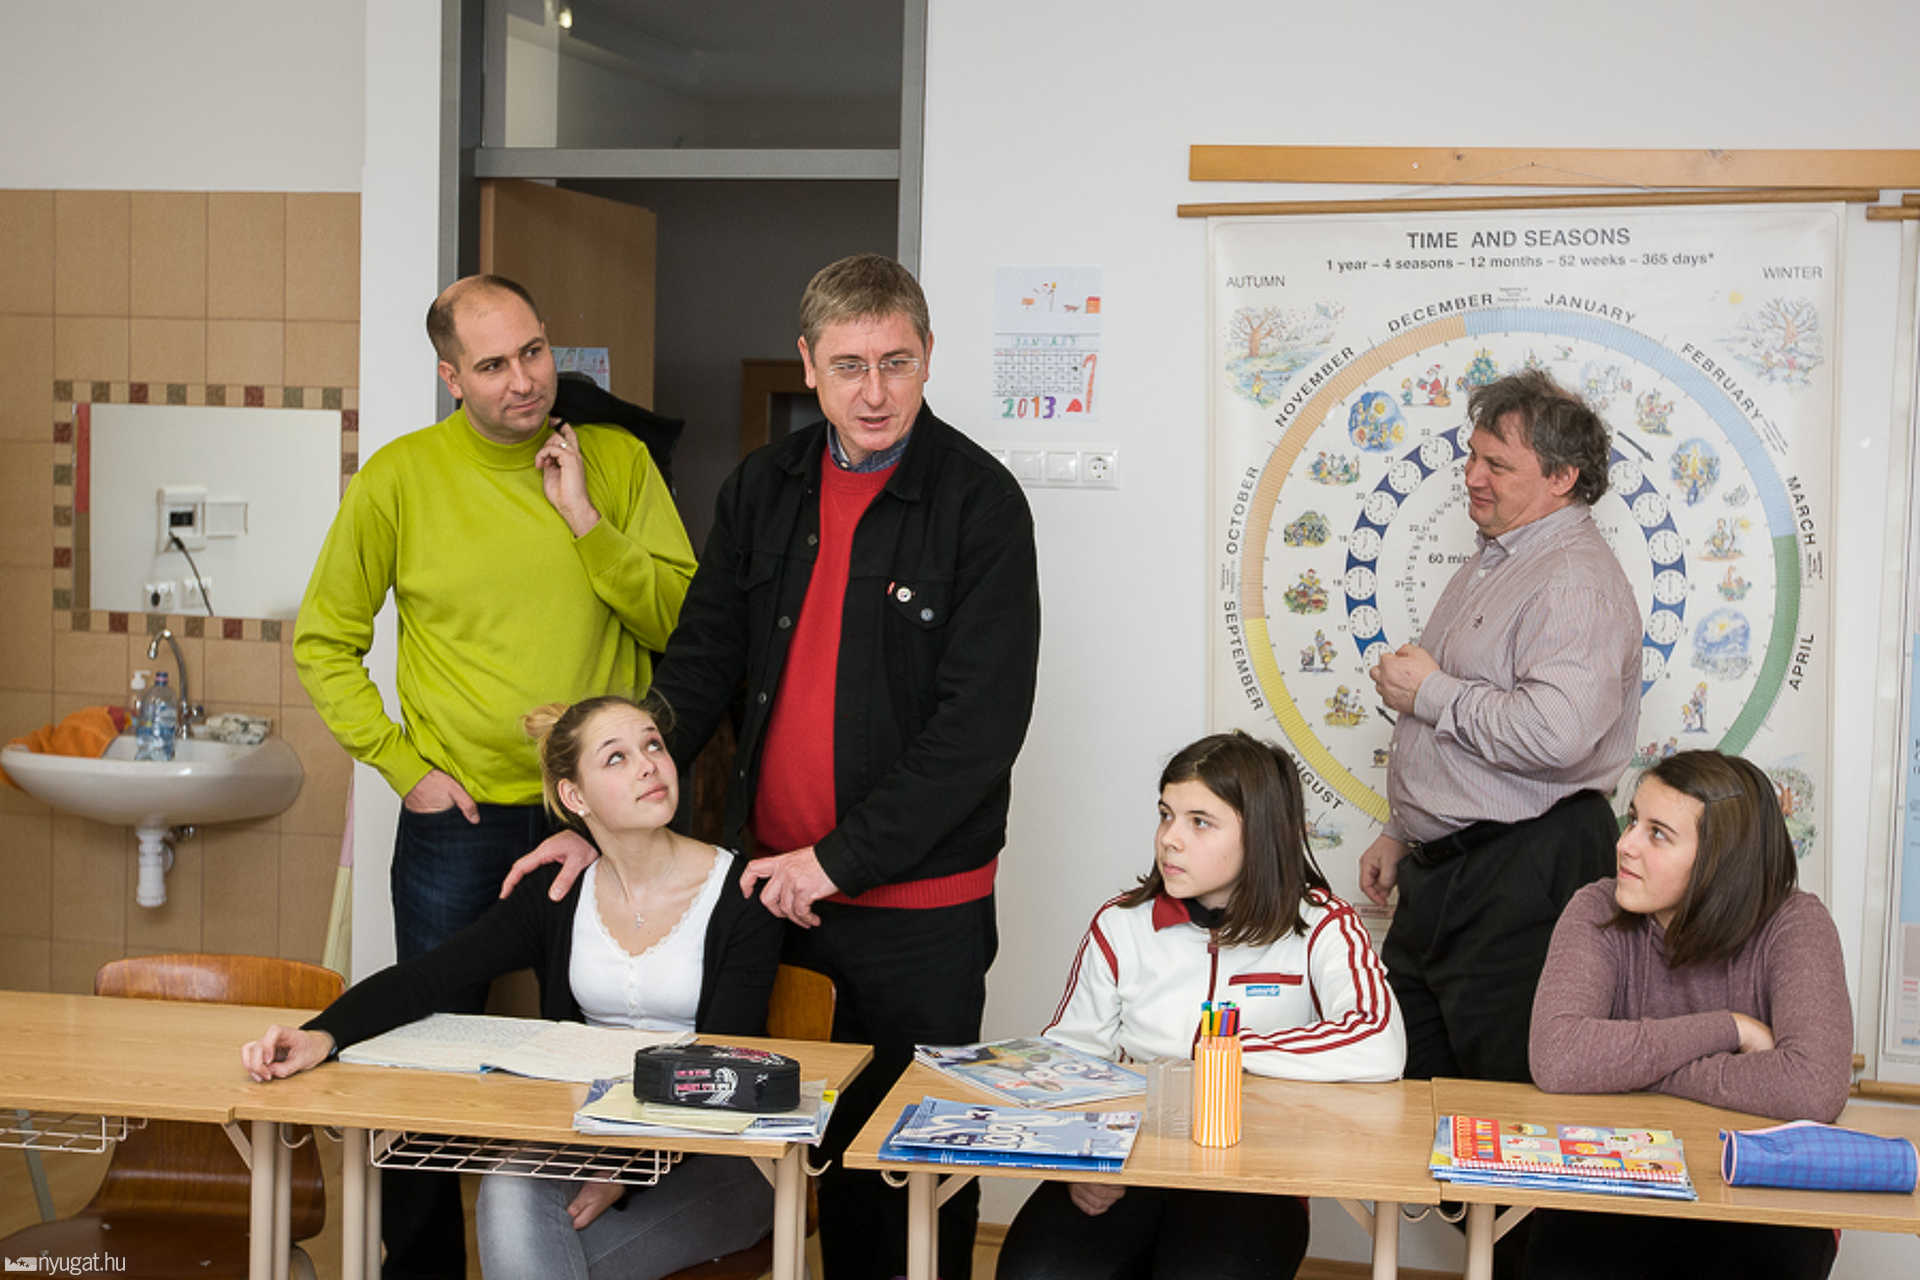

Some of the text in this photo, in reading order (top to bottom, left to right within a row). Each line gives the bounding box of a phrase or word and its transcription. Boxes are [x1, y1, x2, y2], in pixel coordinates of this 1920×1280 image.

[1406, 227, 1631, 249] TIME AND SEASONS
[1226, 275, 1286, 289] AUTUMN
[1337, 259, 1368, 274] year
[1382, 258, 1392, 270] 4
[1395, 259, 1455, 270] seasons
[1470, 256, 1487, 268] 12
[1490, 255, 1544, 268] months
[1558, 255, 1576, 267] 52
[1580, 253, 1627, 267] weeks
[1641, 253, 1669, 266] 365
[1763, 266, 1823, 279] WINTER
[1387, 293, 1494, 332] DECEMBER
[1544, 293, 1637, 325] JANUARY
[1274, 346, 1355, 428] NOVEMBER
[1681, 343, 1763, 420] FEBRUARY
[1226, 466, 1260, 555] OCTOBER
[1786, 475, 1817, 546] MARCH
[1428, 553, 1445, 565] 60
[1223, 600, 1265, 711] SEPTEMBER
[1789, 632, 1816, 691] APRIL
[1290, 752, 1344, 809] UGUST
